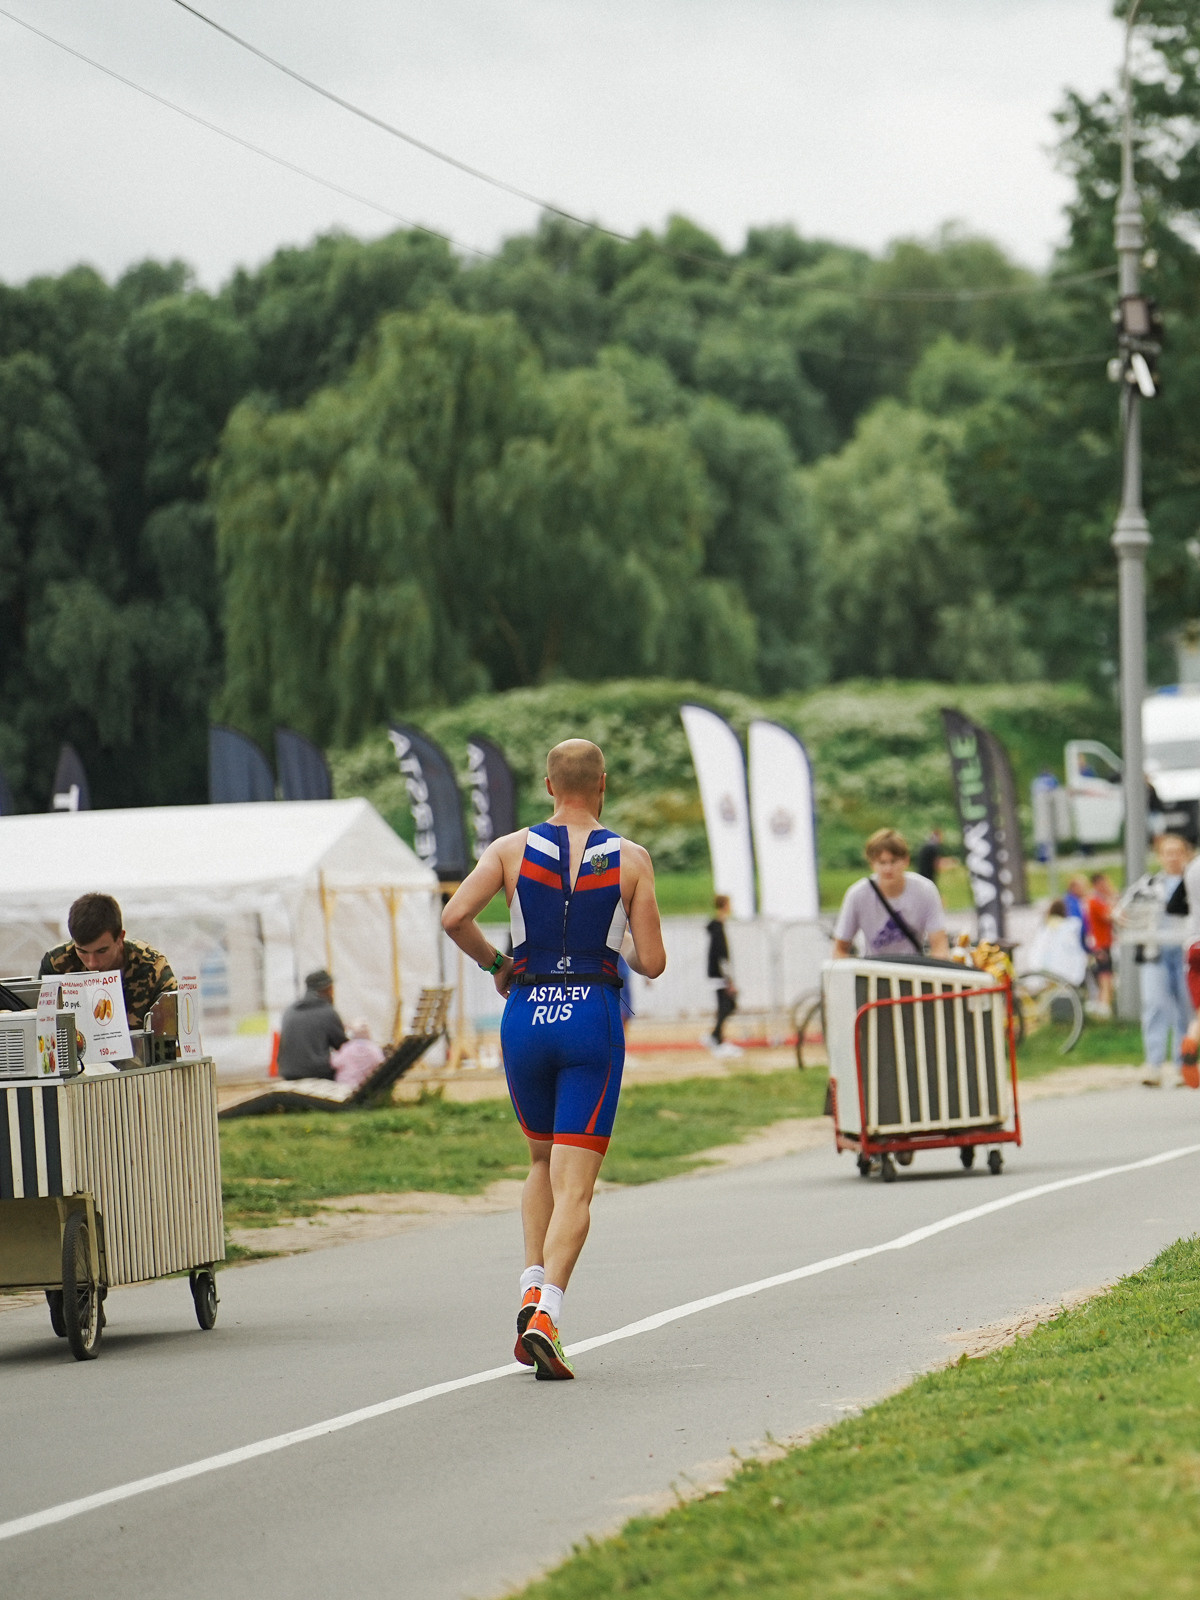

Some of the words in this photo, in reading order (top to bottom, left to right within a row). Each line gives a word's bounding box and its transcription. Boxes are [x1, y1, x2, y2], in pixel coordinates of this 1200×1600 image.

[84, 975, 118, 987] КОРН-ДОГ
[531, 1003, 575, 1026] RUS
[99, 1047, 109, 1056] 150
